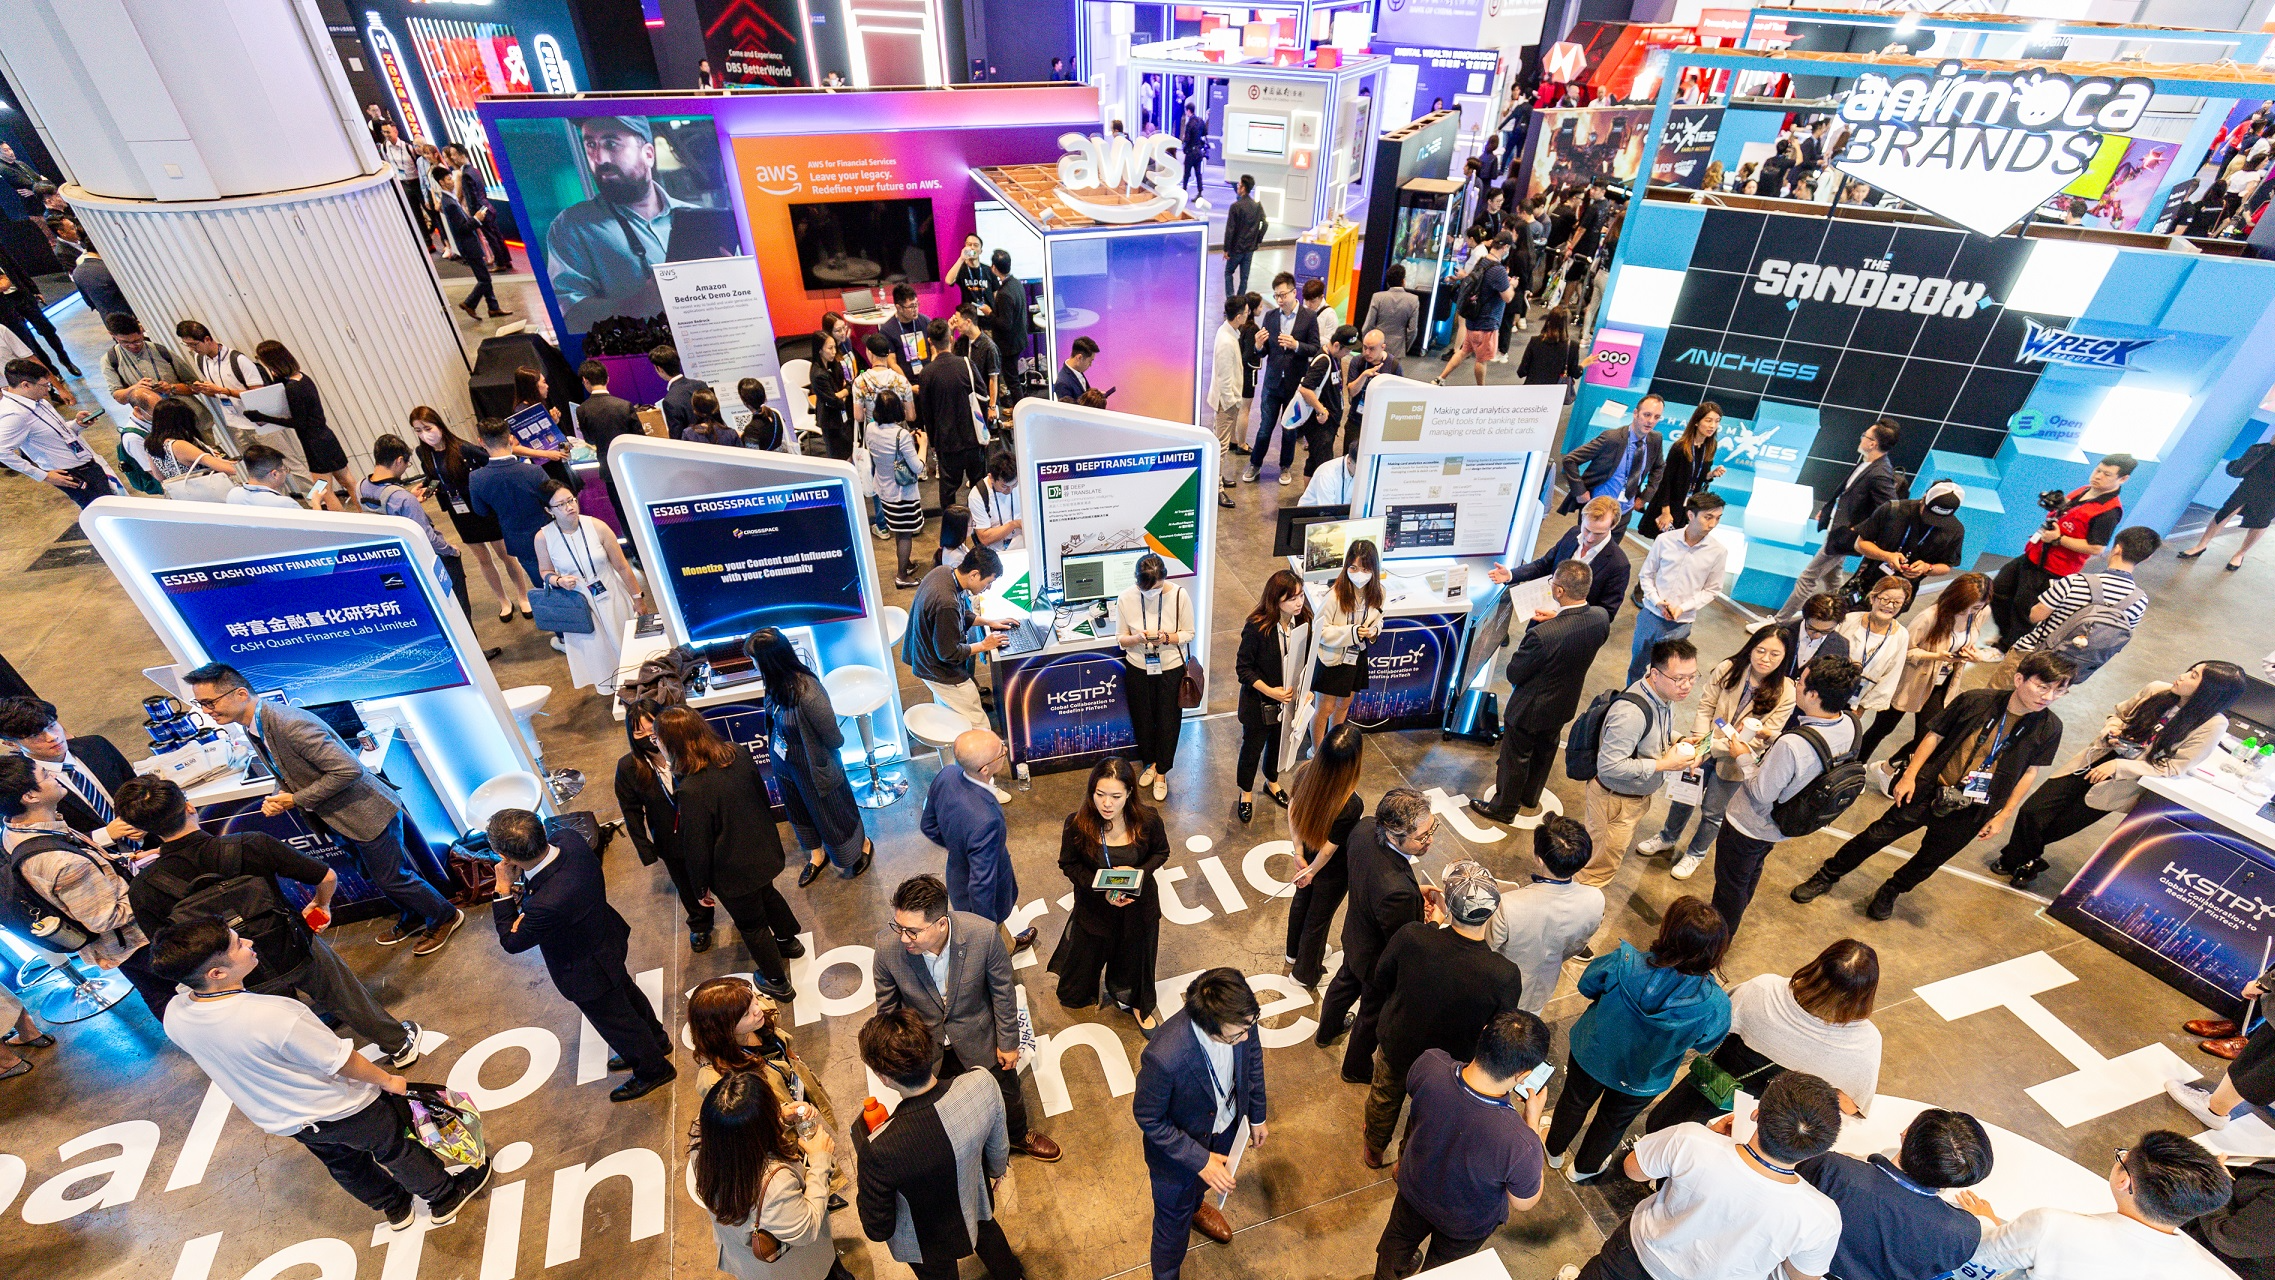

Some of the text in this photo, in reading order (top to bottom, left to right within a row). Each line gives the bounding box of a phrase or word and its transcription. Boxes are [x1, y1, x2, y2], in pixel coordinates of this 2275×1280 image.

[744, 50, 754, 58] and
[755, 51, 783, 60] Experience
[726, 62, 792, 77] DBS BetterWorld
[1845, 124, 2103, 175] BRANDS
[825, 160, 836, 168] for
[837, 159, 868, 167] Financial
[869, 158, 896, 166] Services
[1057, 132, 1185, 192] aws
[756, 165, 798, 182] aws
[810, 170, 893, 182] Leave your legacy.
[812, 180, 942, 195] Redefine your future on AWS.
[1863, 258, 1891, 271] THE
[660, 269, 676, 277] aws
[696, 283, 727, 292] Amazon
[1754, 258, 1986, 319] SANDBOX
[674, 294, 706, 303] Bedrock
[2016, 317, 2155, 366] WRECK
[1675, 348, 1820, 382] ANICHESS
[2045, 353, 2090, 362] LEAGUE
[1434, 405, 1549, 415] Making card analytics accessible.
[1431, 417, 1454, 425] GenAI
[1456, 417, 1474, 425] tools
[1488, 416, 1516, 425] banking
[2050, 415, 2083, 429] Open
[1429, 428, 1463, 436] managing
[1465, 427, 1487, 435] credit
[1495, 427, 1513, 435] debit
[2036, 429, 2081, 439] ampus
[1040, 452, 1194, 475] ES27B DEEPTRANSLATE LIMITED
[1071, 488, 1102, 496] TRANSLATE
[653, 489, 829, 518] ES26B CROSSSPACE HK LIMITED
[743, 526, 779, 535] CROSSSPACE
[161, 547, 401, 588] ES25B CASH QUANT FINANCE LAB LIMITED
[682, 549, 842, 576] Monetize your Content and Influence
[720, 563, 813, 583] with your Community
[225, 600, 402, 640] 時富金融量化研究所
[231, 618, 418, 655] CASH Quant Finance Lab Limited
[1366, 655, 1412, 667] KSTP
[1047, 686, 1105, 705] HKSTP
[1050, 703, 1069, 712] Global
[1070, 700, 1108, 709] Collaboration
[1058, 704, 1107, 716] Redefine FinTech
[2162, 861, 2256, 913] HKSTP
[2159, 877, 2257, 931] Global Collaboration to
[2165, 887, 2239, 930] Redefine FinTech
